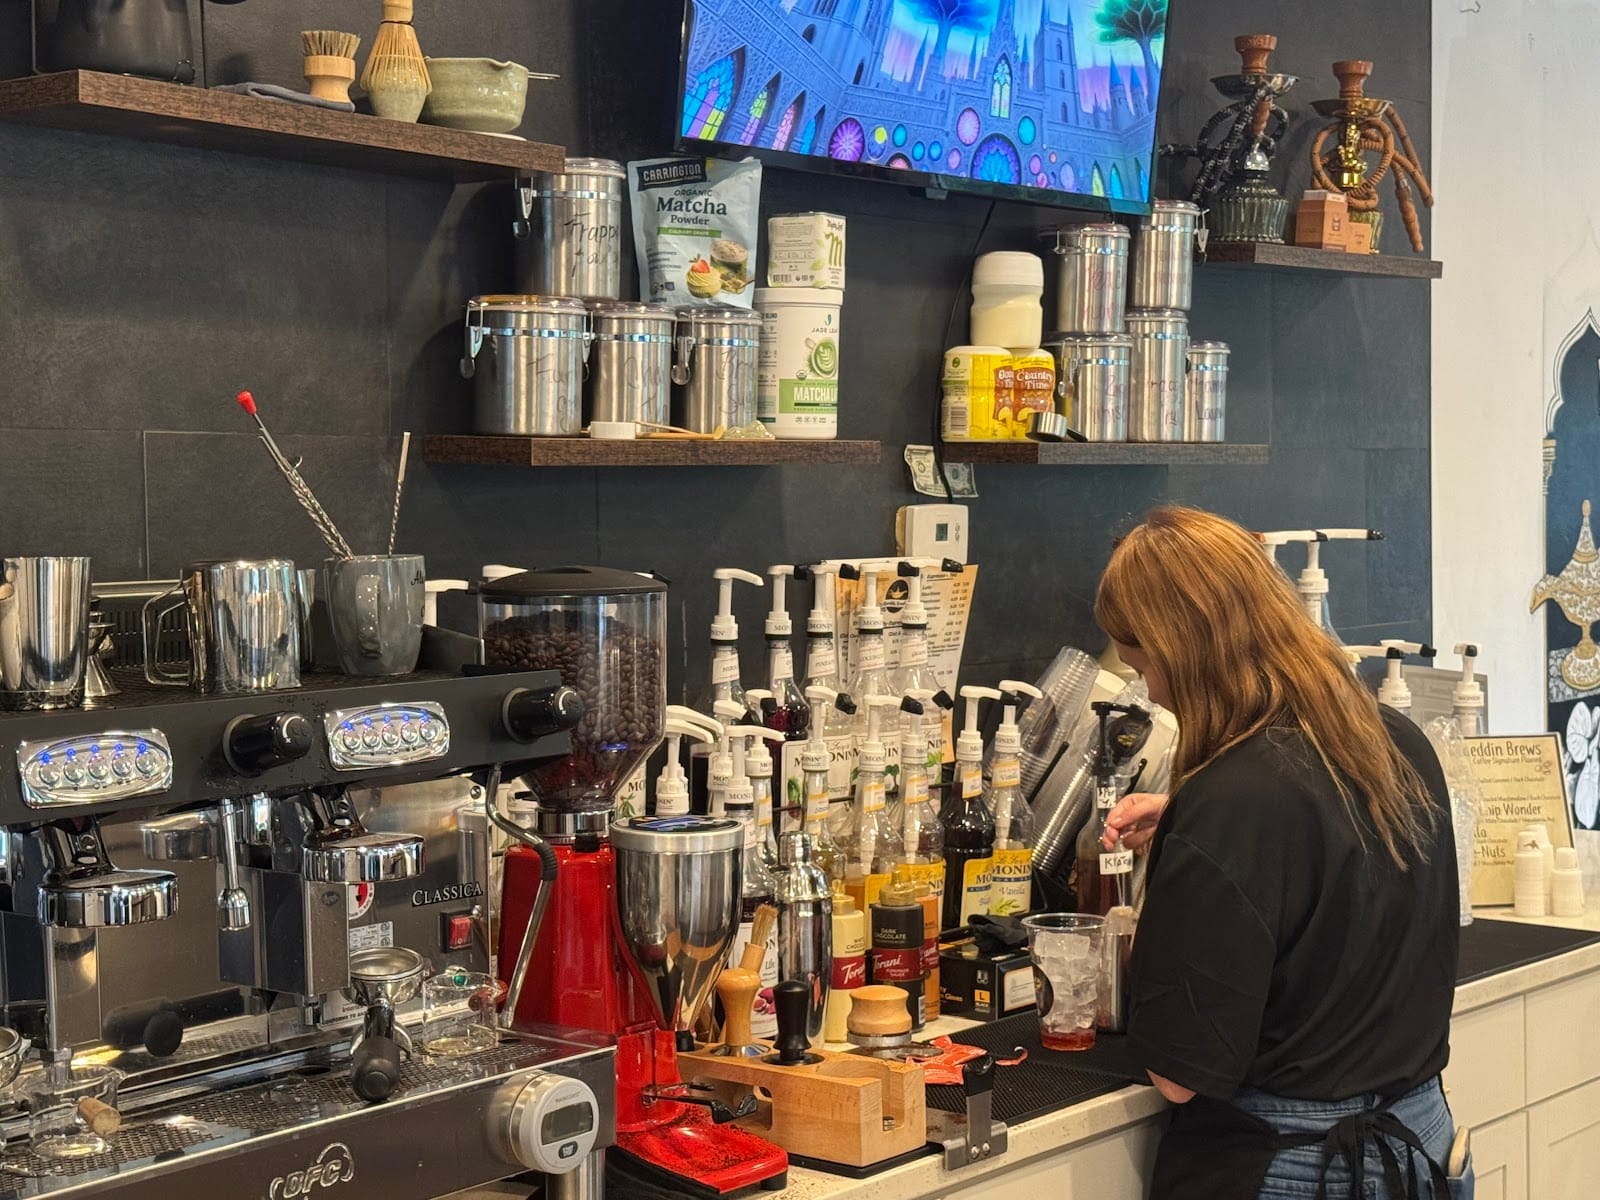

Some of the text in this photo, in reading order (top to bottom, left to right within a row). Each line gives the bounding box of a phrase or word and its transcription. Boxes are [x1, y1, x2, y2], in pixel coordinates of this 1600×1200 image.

[643, 163, 701, 182] CARRINGTON
[674, 189, 713, 197] ORGANIC
[656, 196, 728, 216] Matcha
[670, 214, 710, 226] Powder
[1016, 369, 1053, 382] Country
[1024, 380, 1050, 390] Time
[794, 386, 830, 402] MATCHA
[1506, 741, 1542, 756] Brews
[1502, 803, 1542, 816] Wonder
[411, 882, 483, 906] CLASSICA
[979, 991, 985, 1000] L
